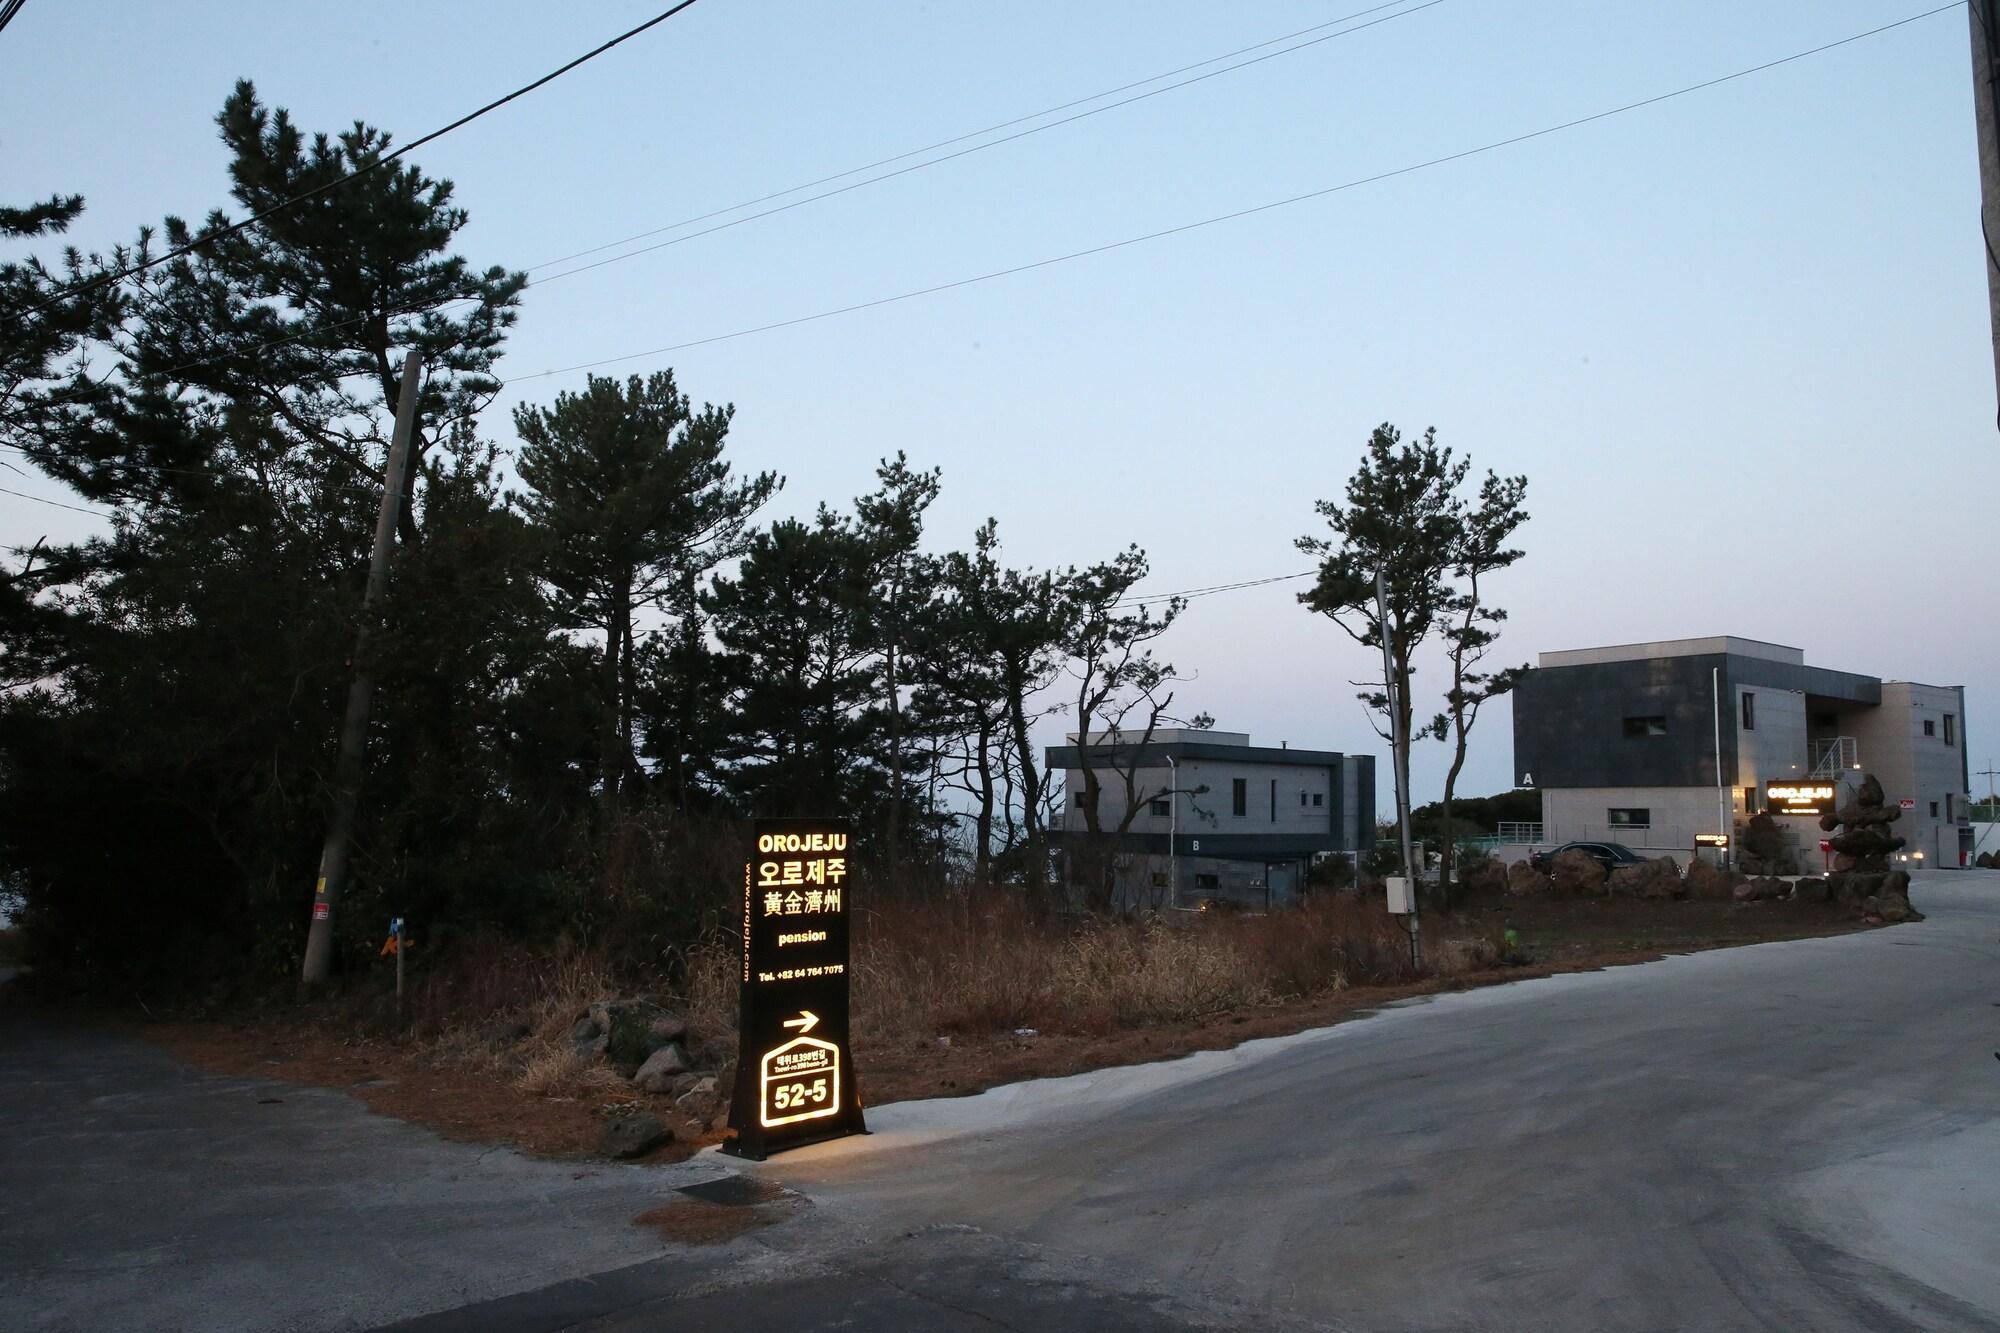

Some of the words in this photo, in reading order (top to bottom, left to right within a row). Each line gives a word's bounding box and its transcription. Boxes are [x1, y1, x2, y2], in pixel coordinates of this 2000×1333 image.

[1523, 772, 1533, 784] A
[758, 834, 847, 853] OROJEJU
[1192, 840, 1200, 851] B
[758, 858, 846, 886] 오로제주
[778, 930, 826, 946] pension
[758, 971, 775, 982] Tel.
[777, 970, 793, 980] +82
[794, 968, 806, 978] 64
[807, 966, 823, 977] 764
[823, 964, 844, 975] 7075
[775, 1079, 826, 1109] 52-5
